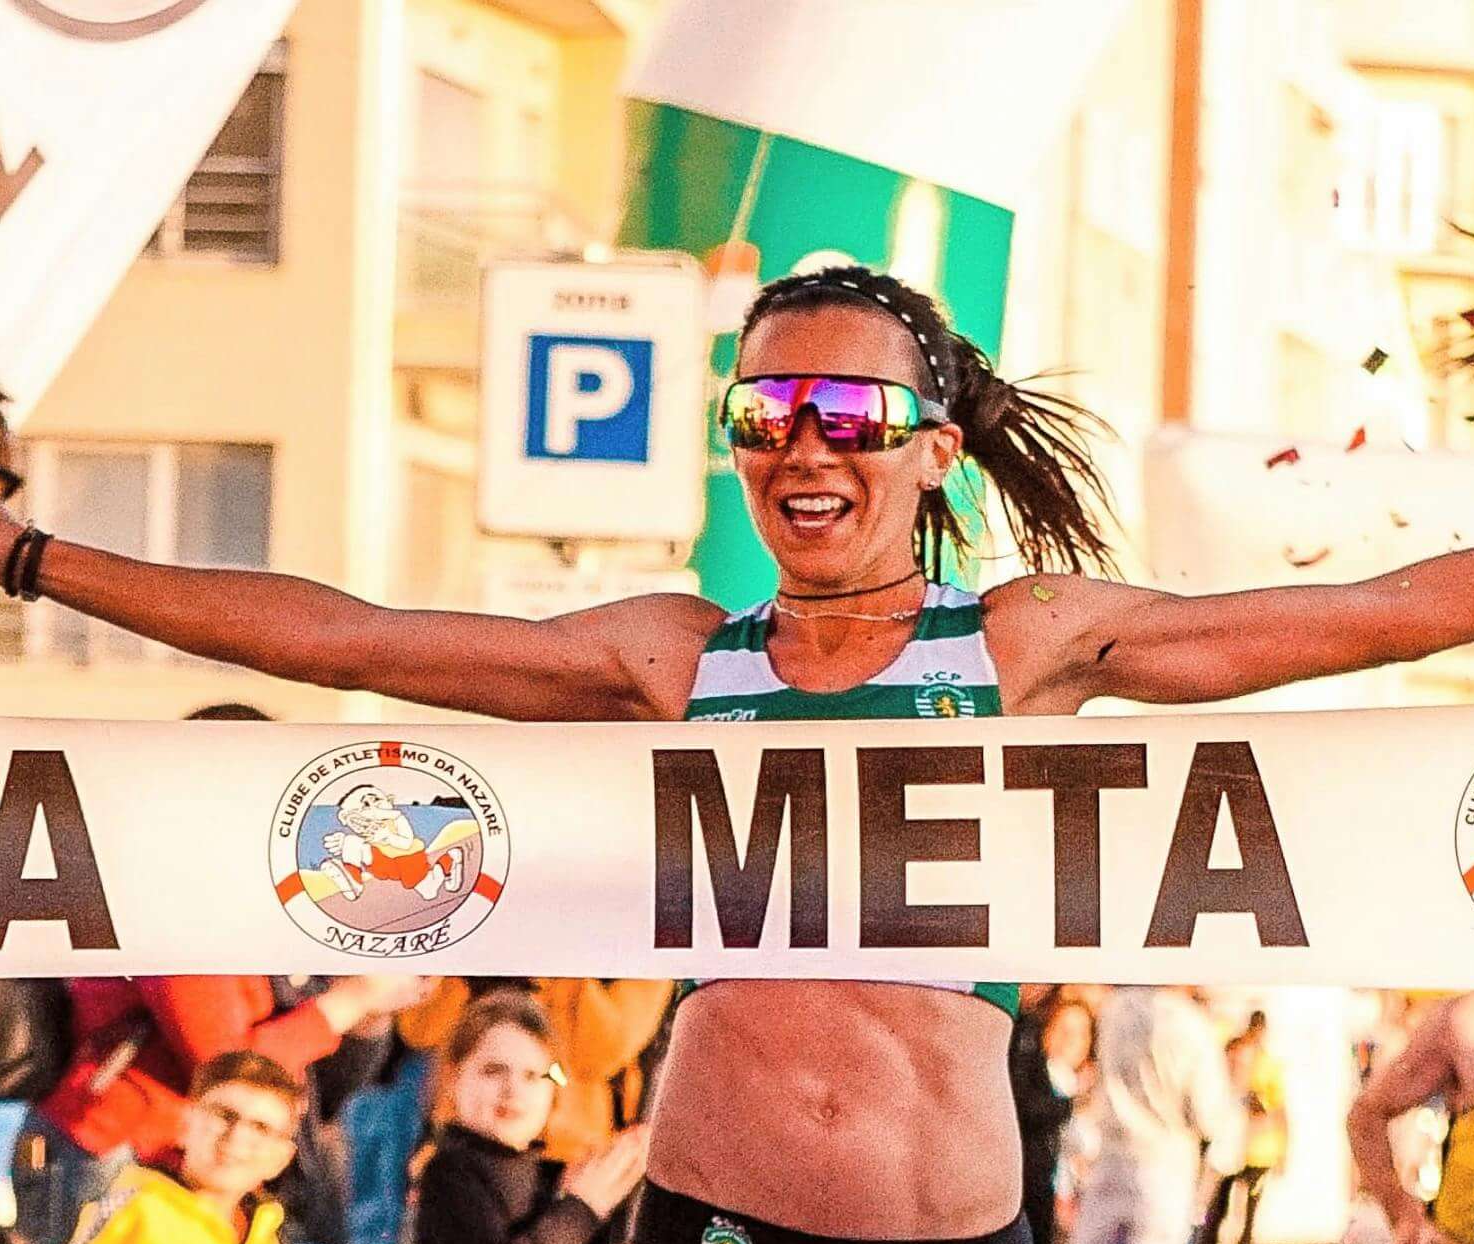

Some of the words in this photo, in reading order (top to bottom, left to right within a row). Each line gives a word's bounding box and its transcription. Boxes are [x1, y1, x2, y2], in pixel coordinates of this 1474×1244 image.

[544, 343, 634, 455] P
[279, 784, 310, 838] CLUBE
[308, 764, 330, 784] DE
[333, 748, 429, 769] ATLETISMO
[434, 757, 455, 776] DA
[457, 773, 503, 836] NAZARÉ
[651, 740, 1310, 949] META
[324, 918, 451, 956] NAZARÉ
